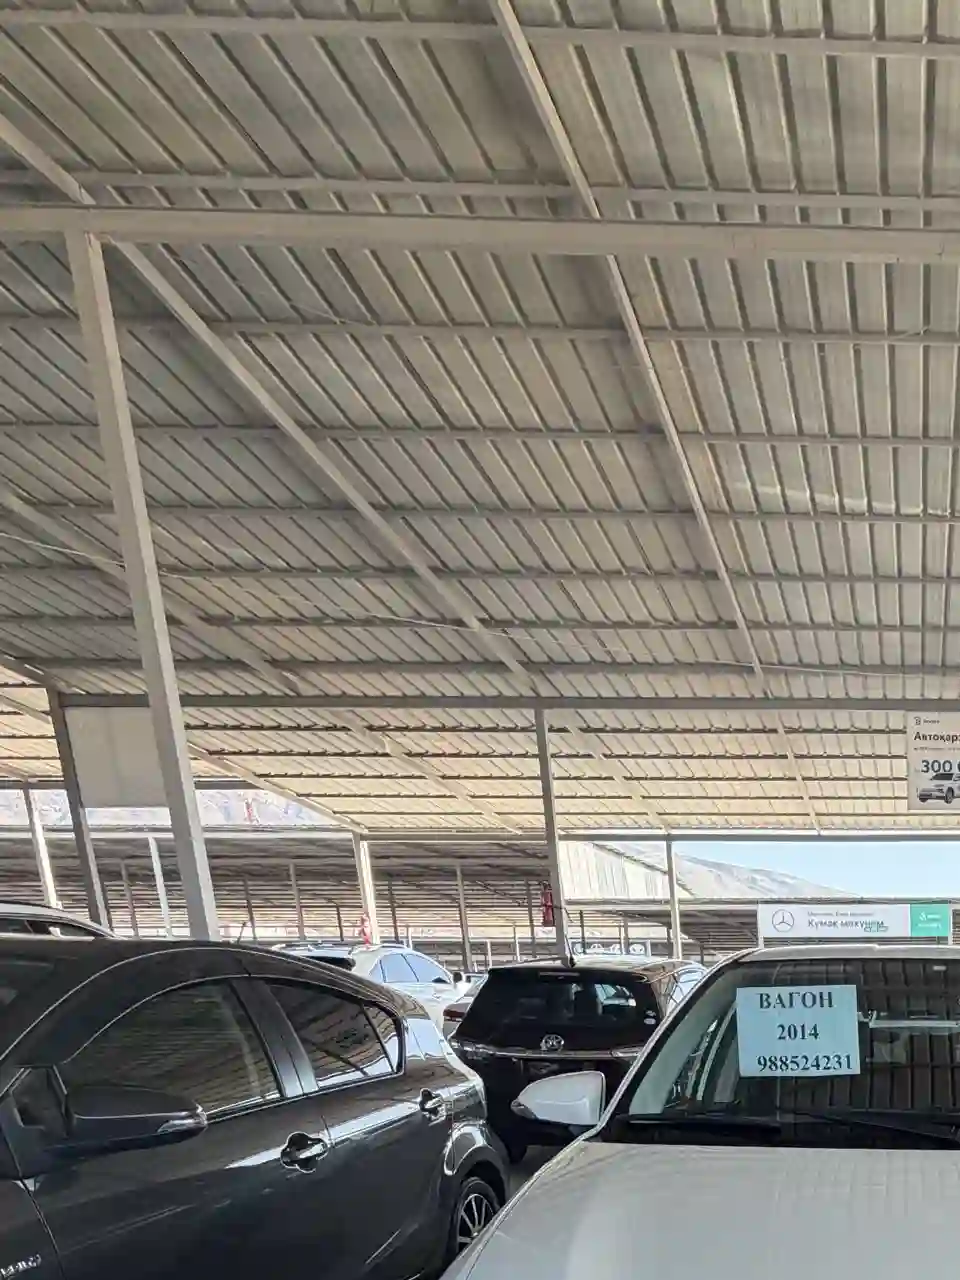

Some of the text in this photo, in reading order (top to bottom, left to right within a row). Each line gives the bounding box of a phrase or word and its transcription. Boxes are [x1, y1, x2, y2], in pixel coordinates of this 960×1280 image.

[921, 759, 953, 774] 300
[757, 991, 834, 1009] ВАГОН
[776, 1023, 820, 1040] 2014
[756, 1053, 853, 1072] 988524231
